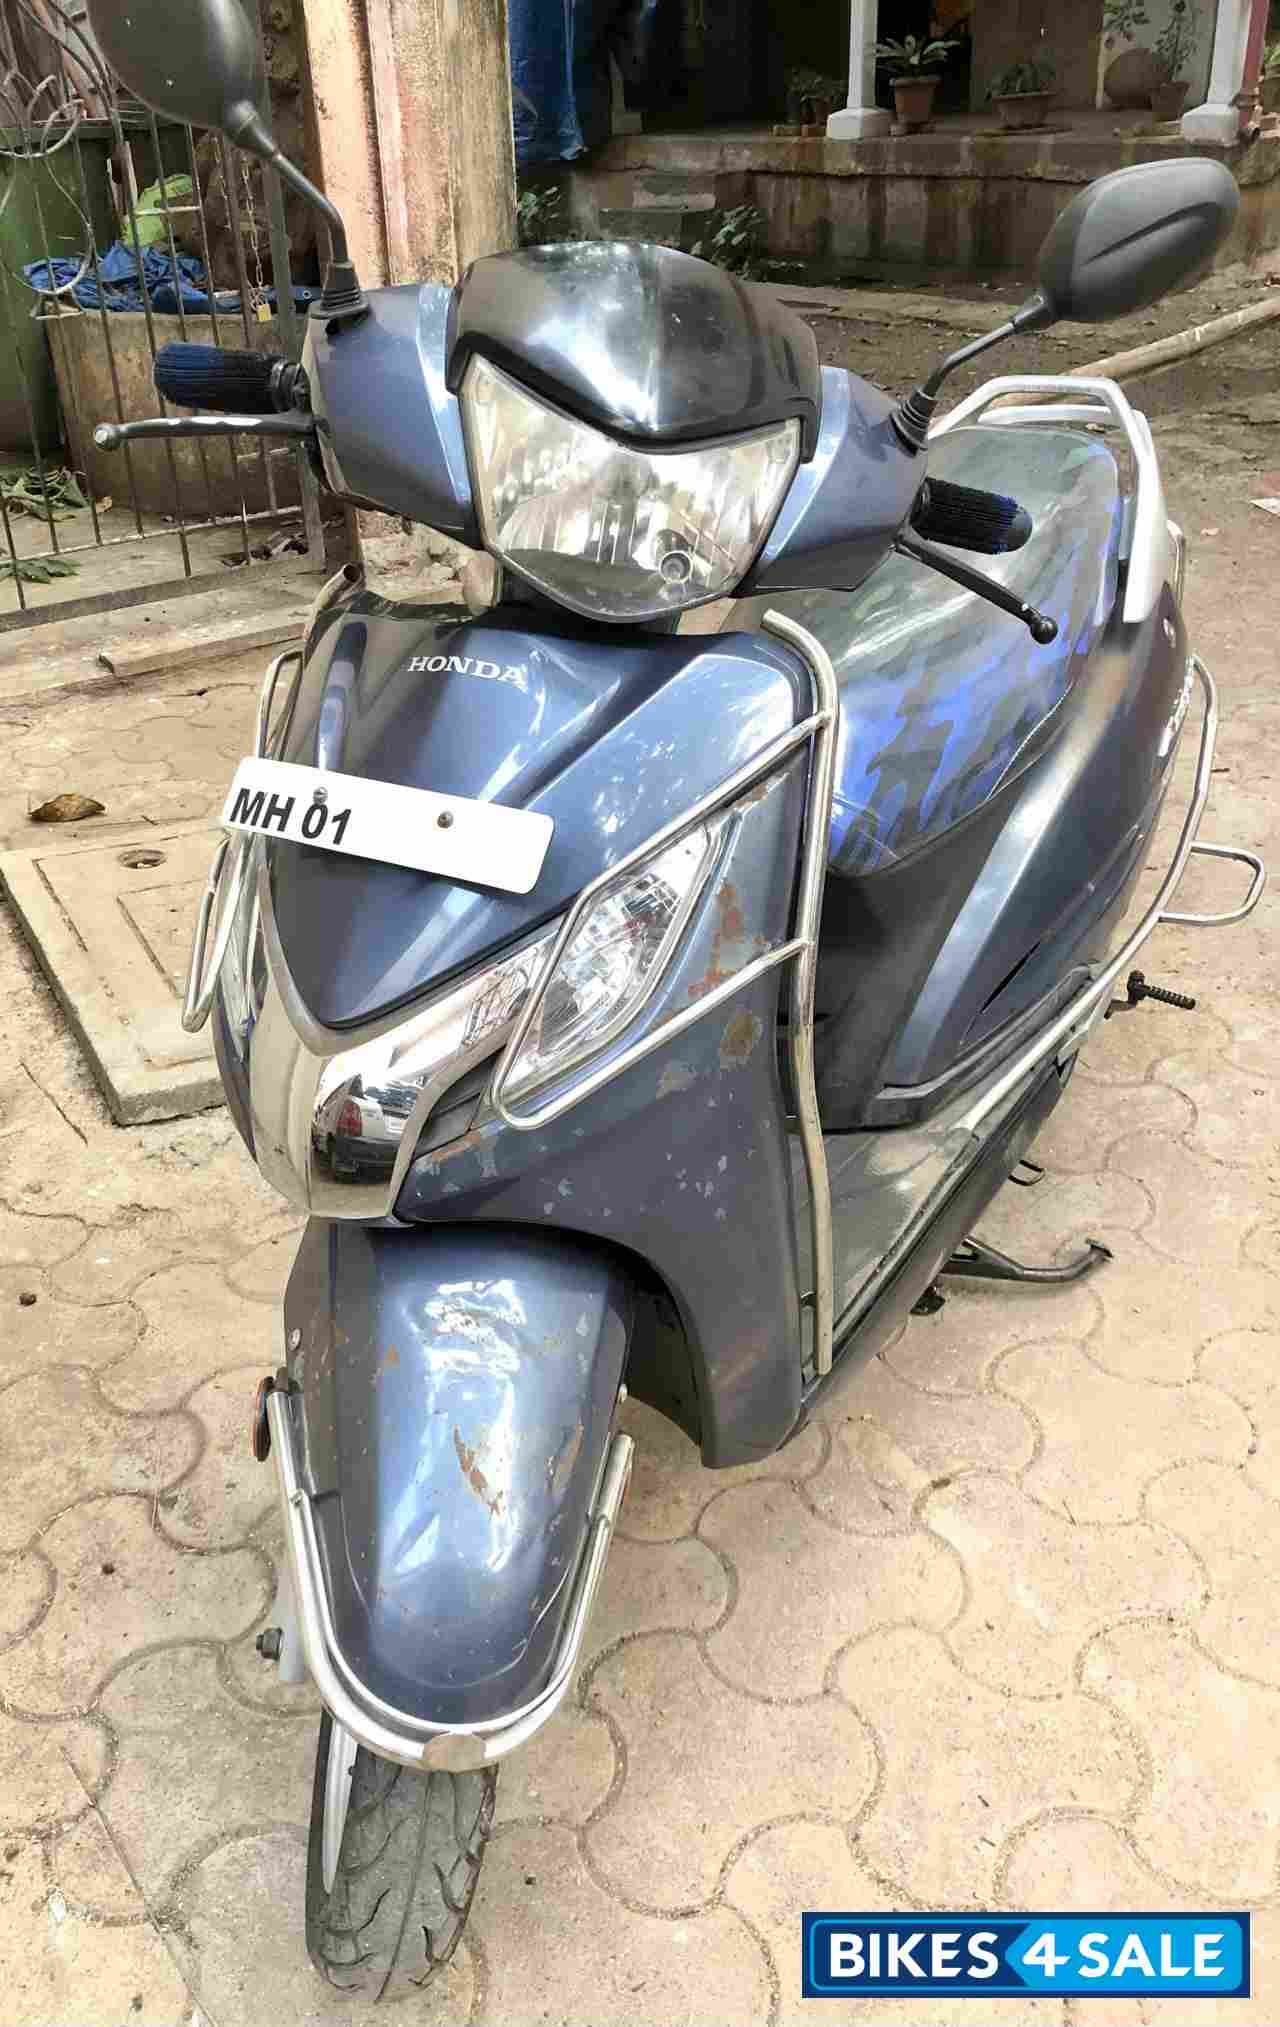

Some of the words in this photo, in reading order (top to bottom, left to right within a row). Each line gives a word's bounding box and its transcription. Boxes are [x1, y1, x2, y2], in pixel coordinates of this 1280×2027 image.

[407, 655, 529, 694] HONDA
[229, 787, 296, 832] MH
[301, 803, 352, 845] 01
